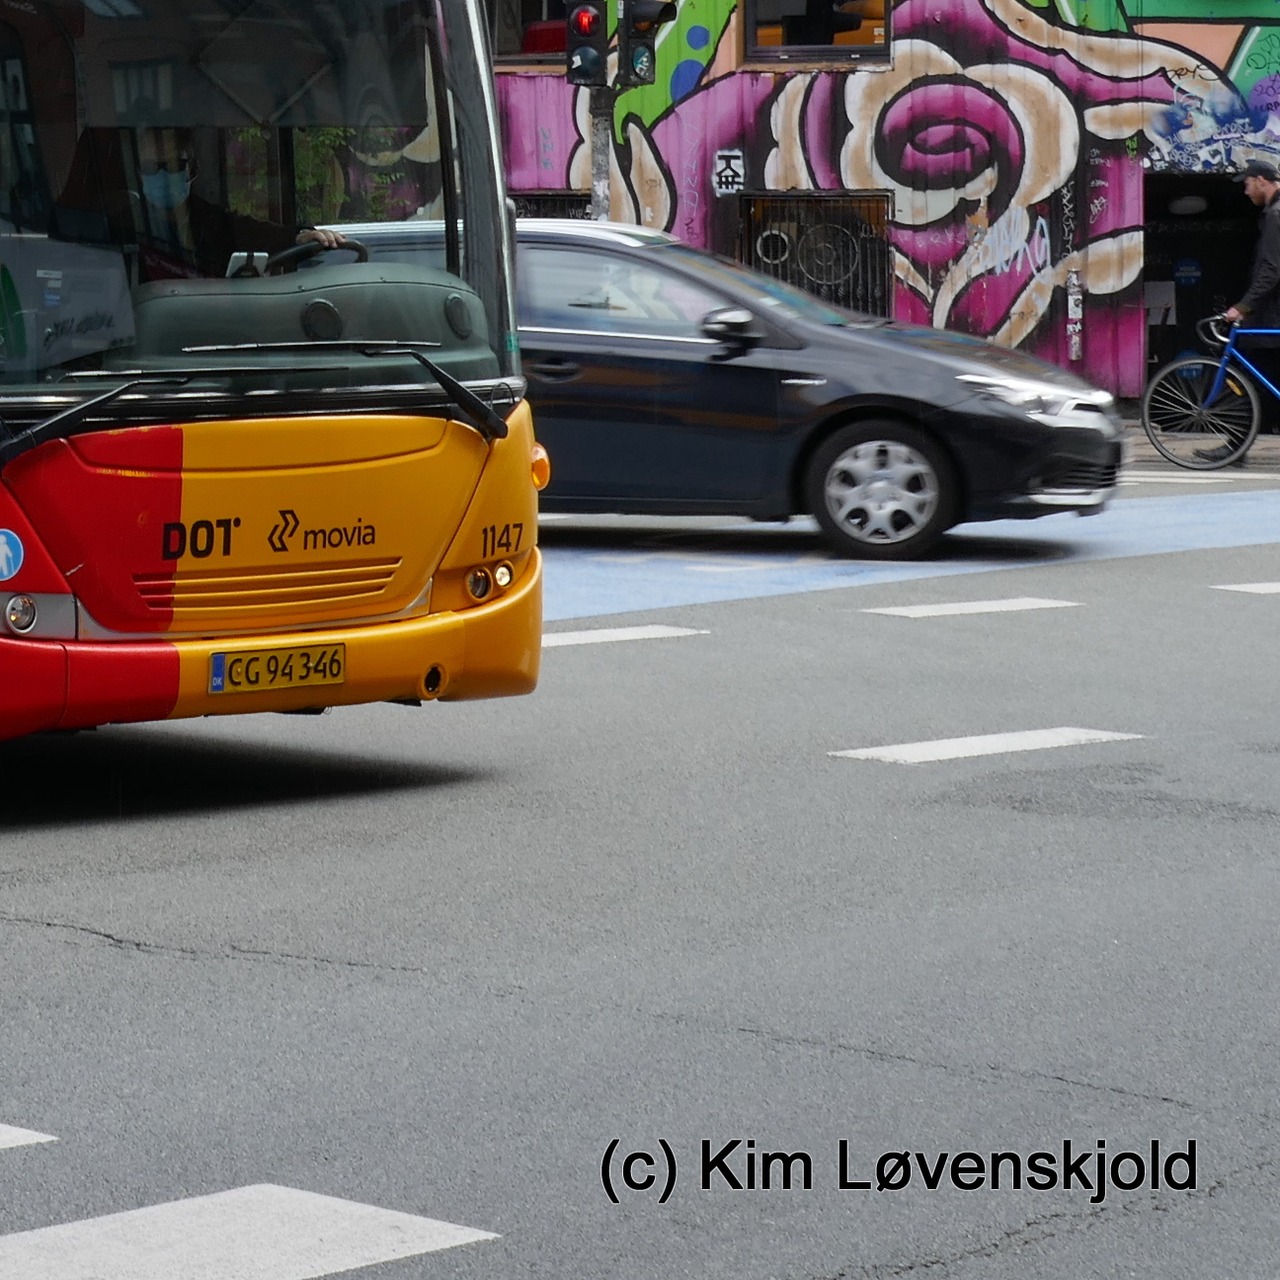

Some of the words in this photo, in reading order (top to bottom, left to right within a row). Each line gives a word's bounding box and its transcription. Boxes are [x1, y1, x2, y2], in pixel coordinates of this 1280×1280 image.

[161, 517, 242, 560] DOT
[303, 517, 377, 552] movia
[481, 522, 523, 559] 1147
[212, 676, 223, 686] DK
